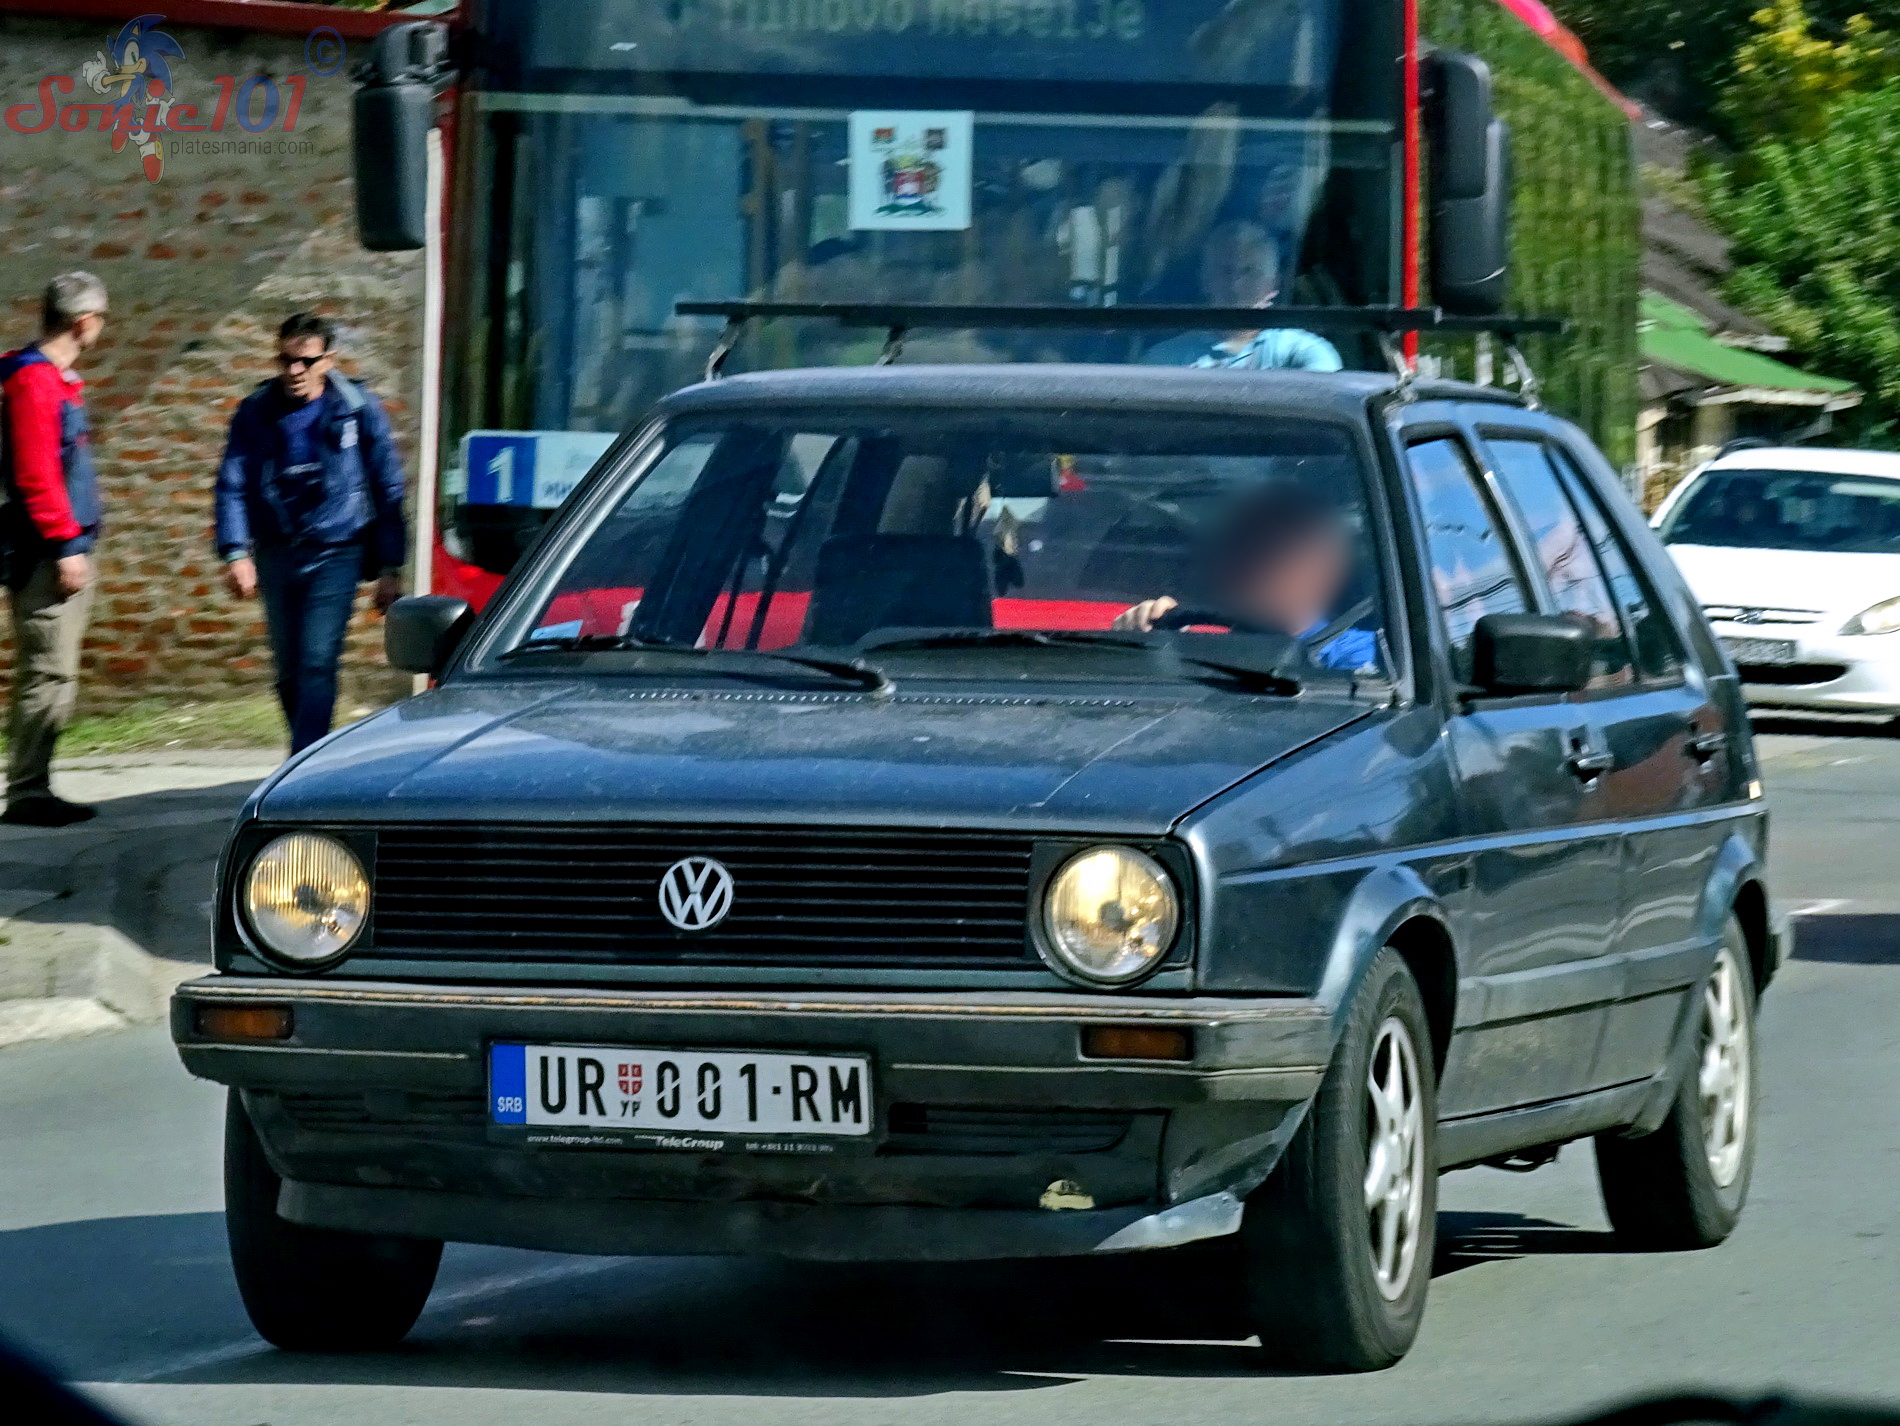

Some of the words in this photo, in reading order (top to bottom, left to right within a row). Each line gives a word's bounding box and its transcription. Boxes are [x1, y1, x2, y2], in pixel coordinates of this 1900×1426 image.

[486, 446, 515, 504] 1
[497, 1096, 523, 1113] SRB
[539, 1055, 607, 1117] UR
[655, 1135, 724, 1151] TeleGroup
